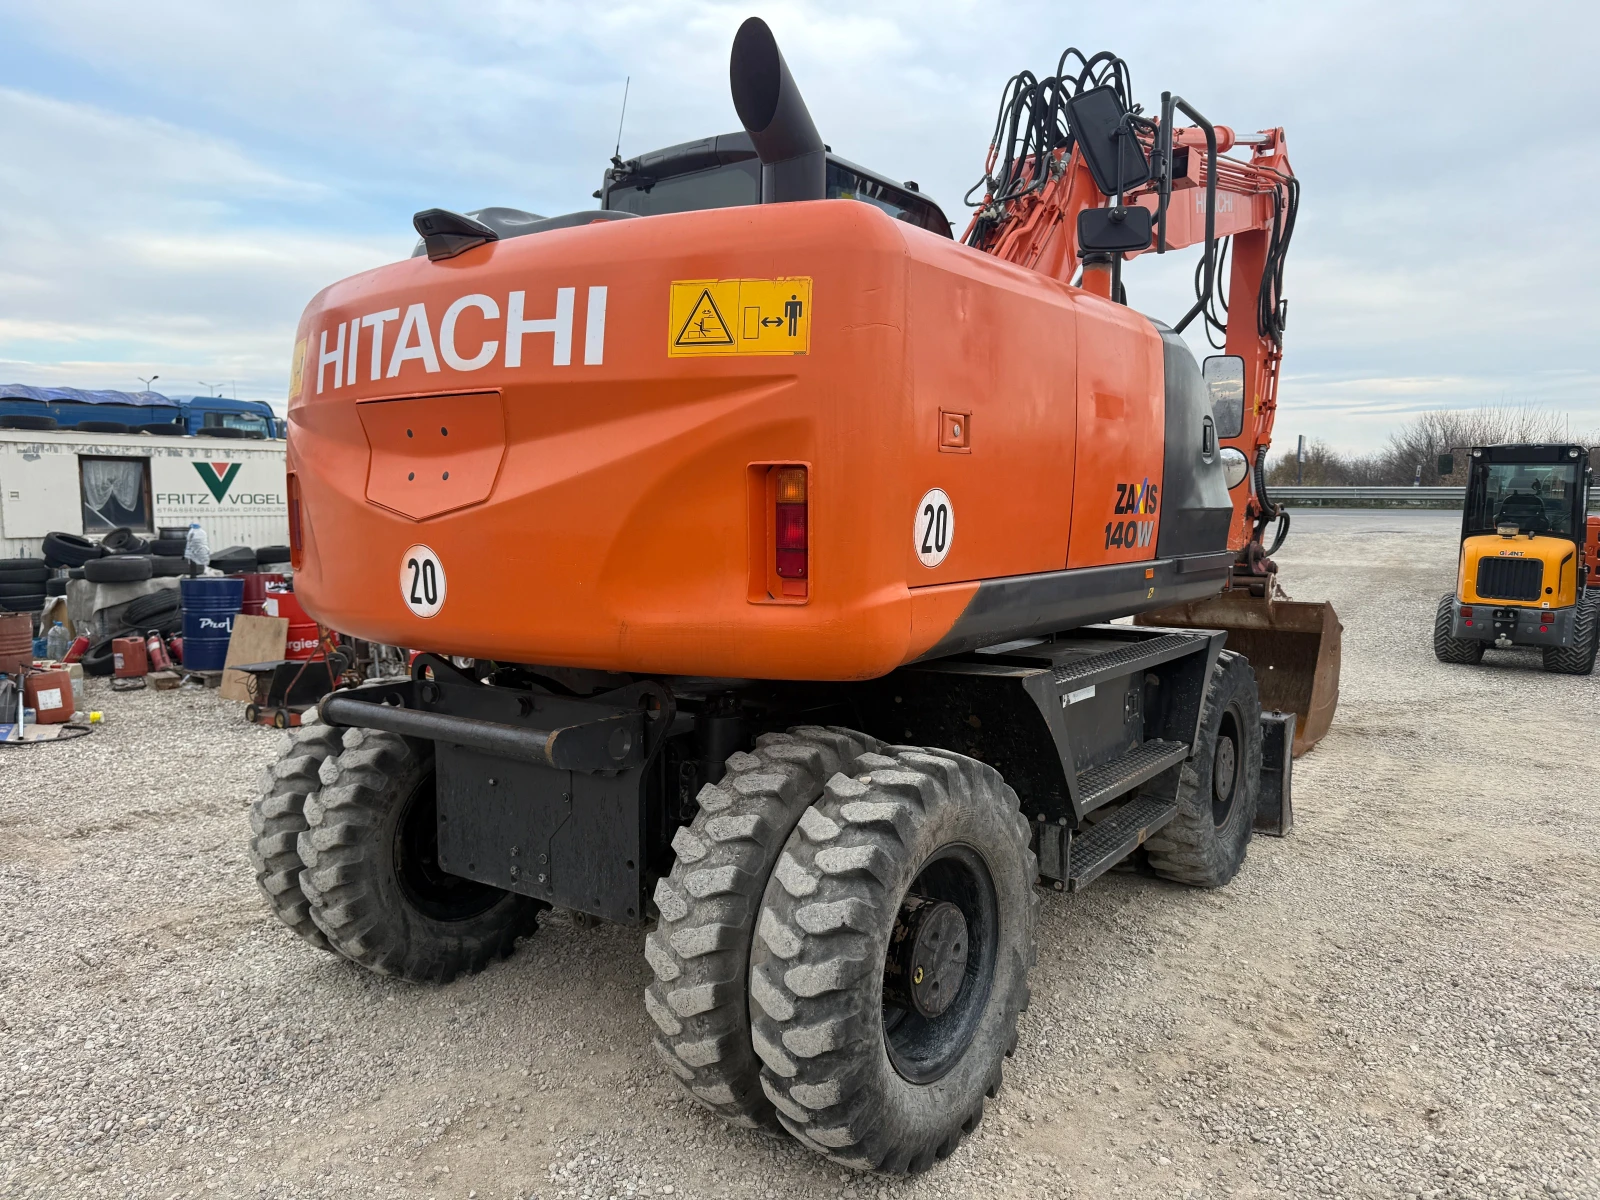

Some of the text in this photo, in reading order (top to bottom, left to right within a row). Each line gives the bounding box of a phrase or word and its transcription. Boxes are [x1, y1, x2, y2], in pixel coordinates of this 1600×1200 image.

[316, 285, 608, 395] HITACHI
[156, 493, 286, 505] FRITZ VOGEL
[1114, 477, 1158, 515] ZAXIS
[921, 503, 948, 554] 20
[1104, 520, 1156, 550] 140W
[407, 558, 437, 606] 20
[286, 637, 320, 652] rgies
